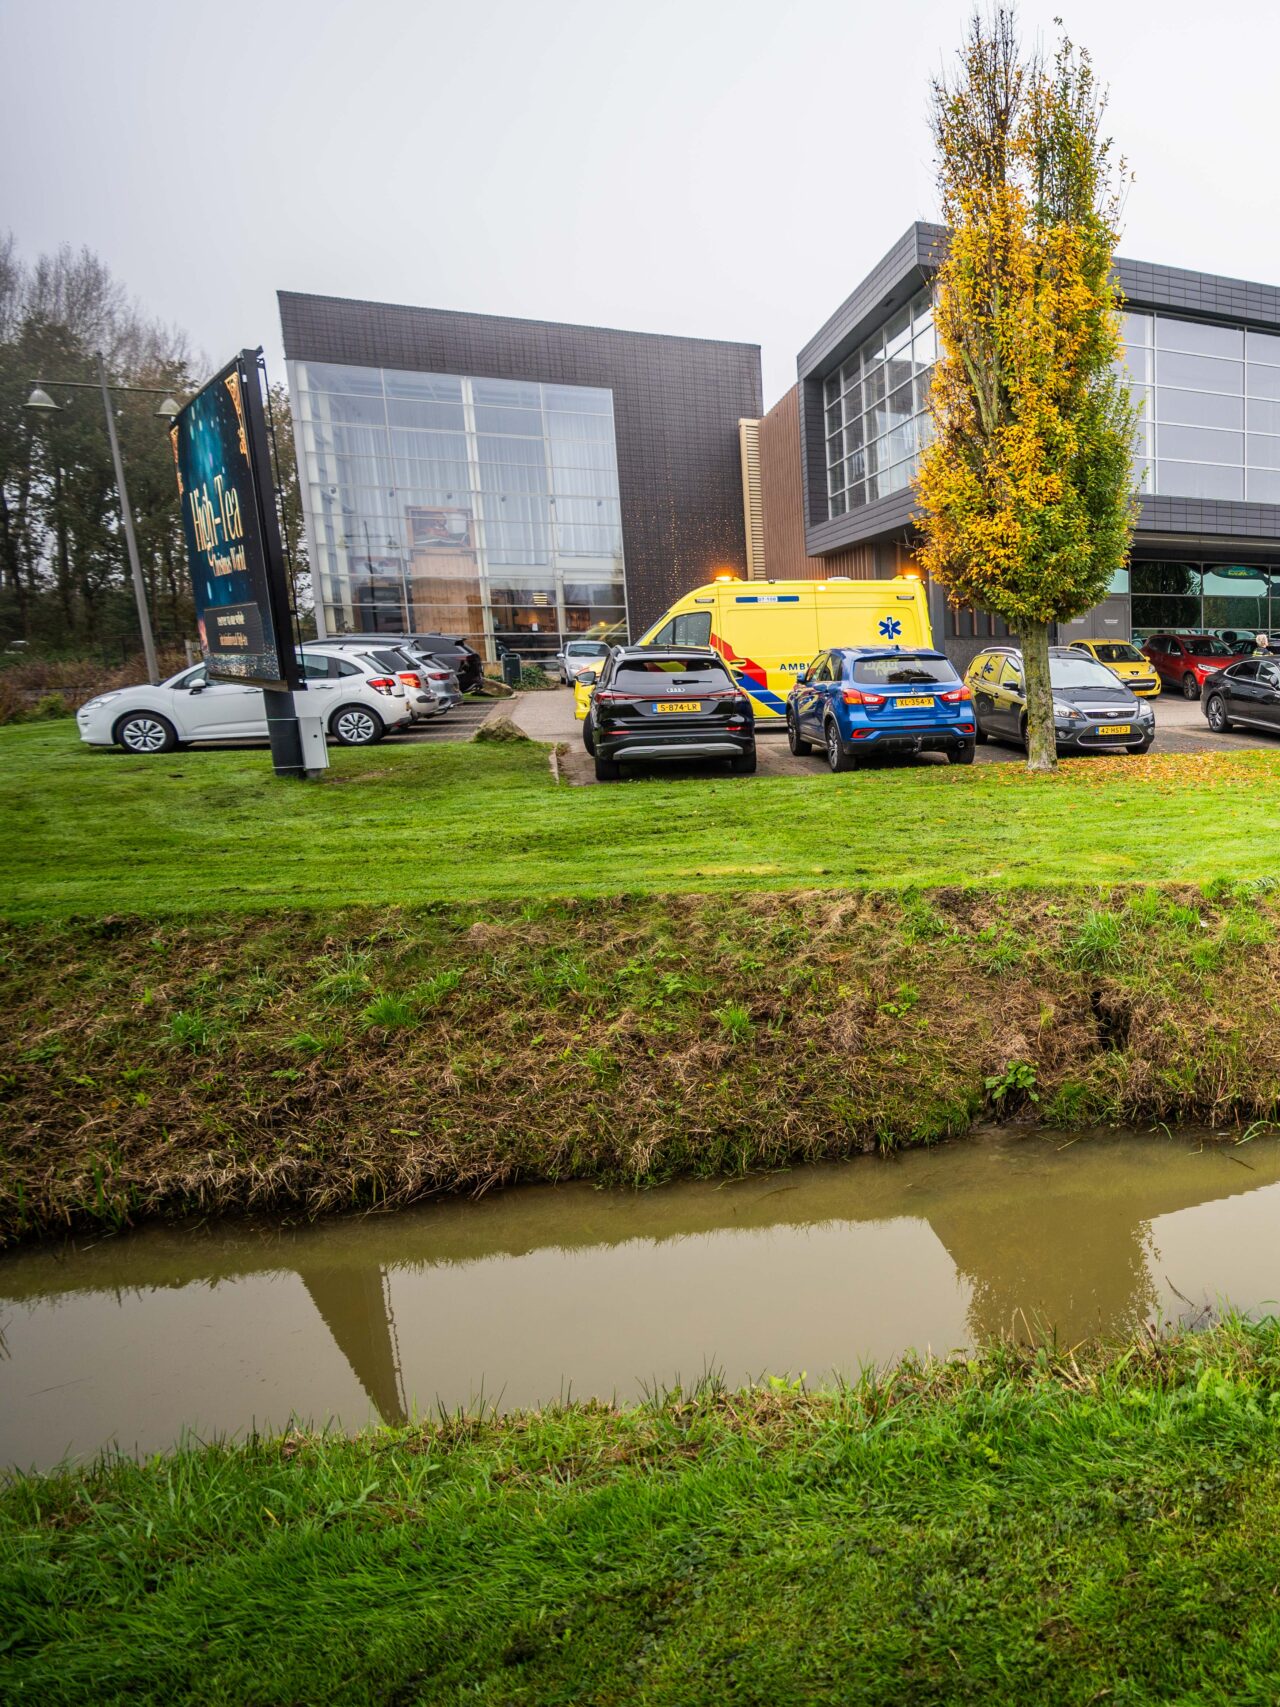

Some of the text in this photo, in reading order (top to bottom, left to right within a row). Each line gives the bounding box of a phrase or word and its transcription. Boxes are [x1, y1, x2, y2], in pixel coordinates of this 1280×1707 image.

[189, 474, 244, 567] High-Tea
[660, 703, 698, 712] S-874-LR
[1101, 726, 1129, 734] 42-HST-3
